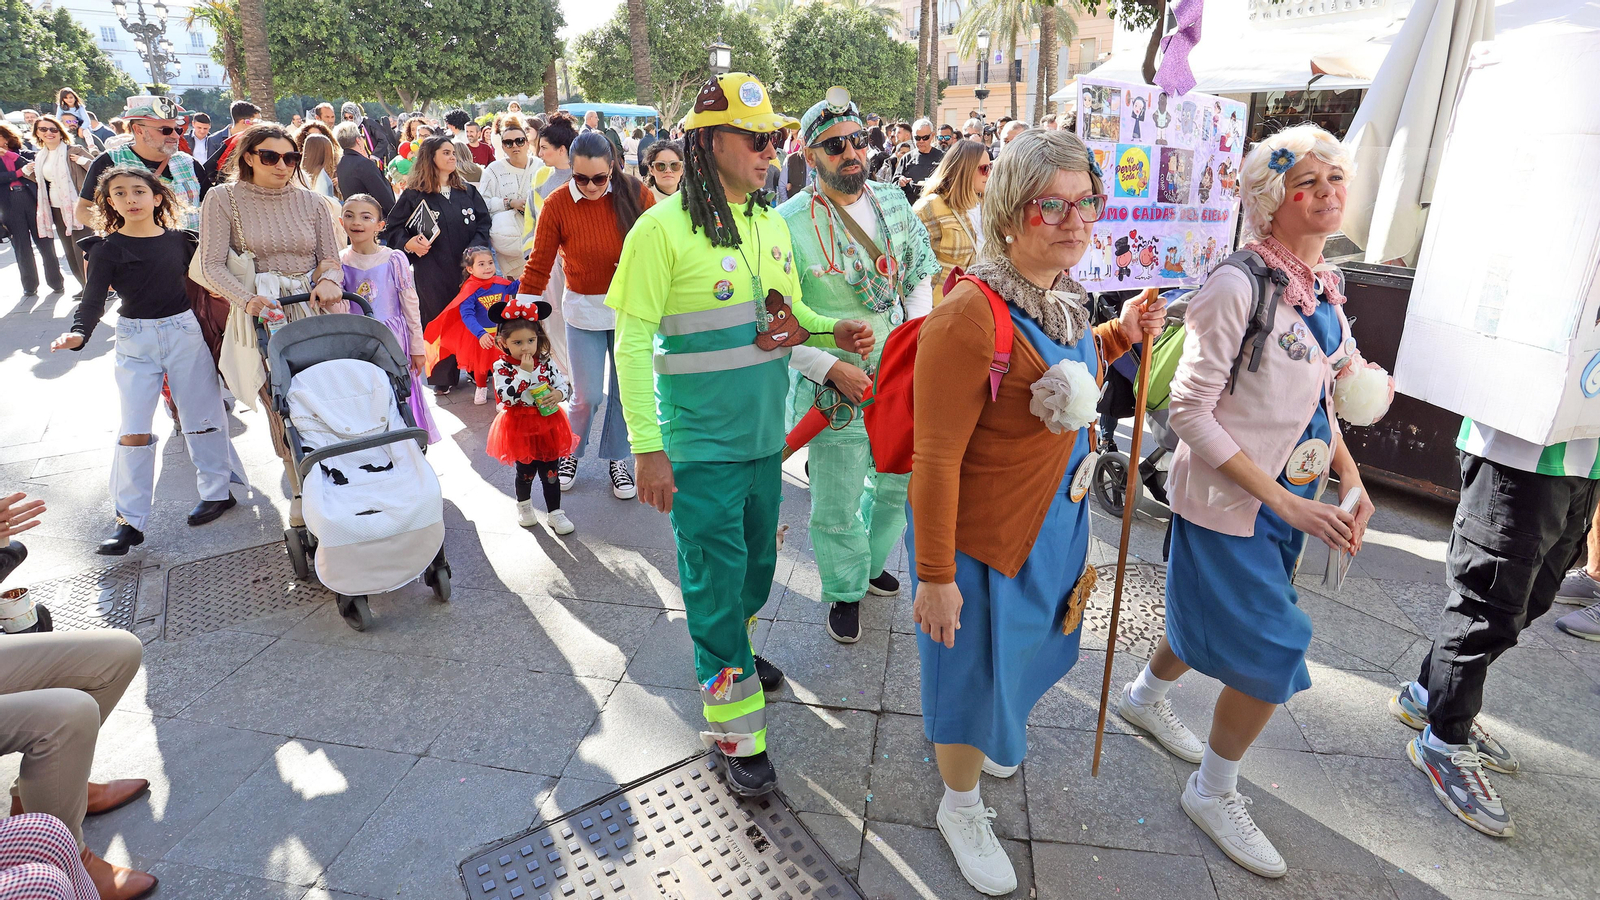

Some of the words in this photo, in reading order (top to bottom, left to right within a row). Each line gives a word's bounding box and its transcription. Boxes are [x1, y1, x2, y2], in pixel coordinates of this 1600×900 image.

[1100, 206, 1128, 221] MO
[1180, 207, 1198, 221] DEL
[479, 294, 502, 303] SUPER
